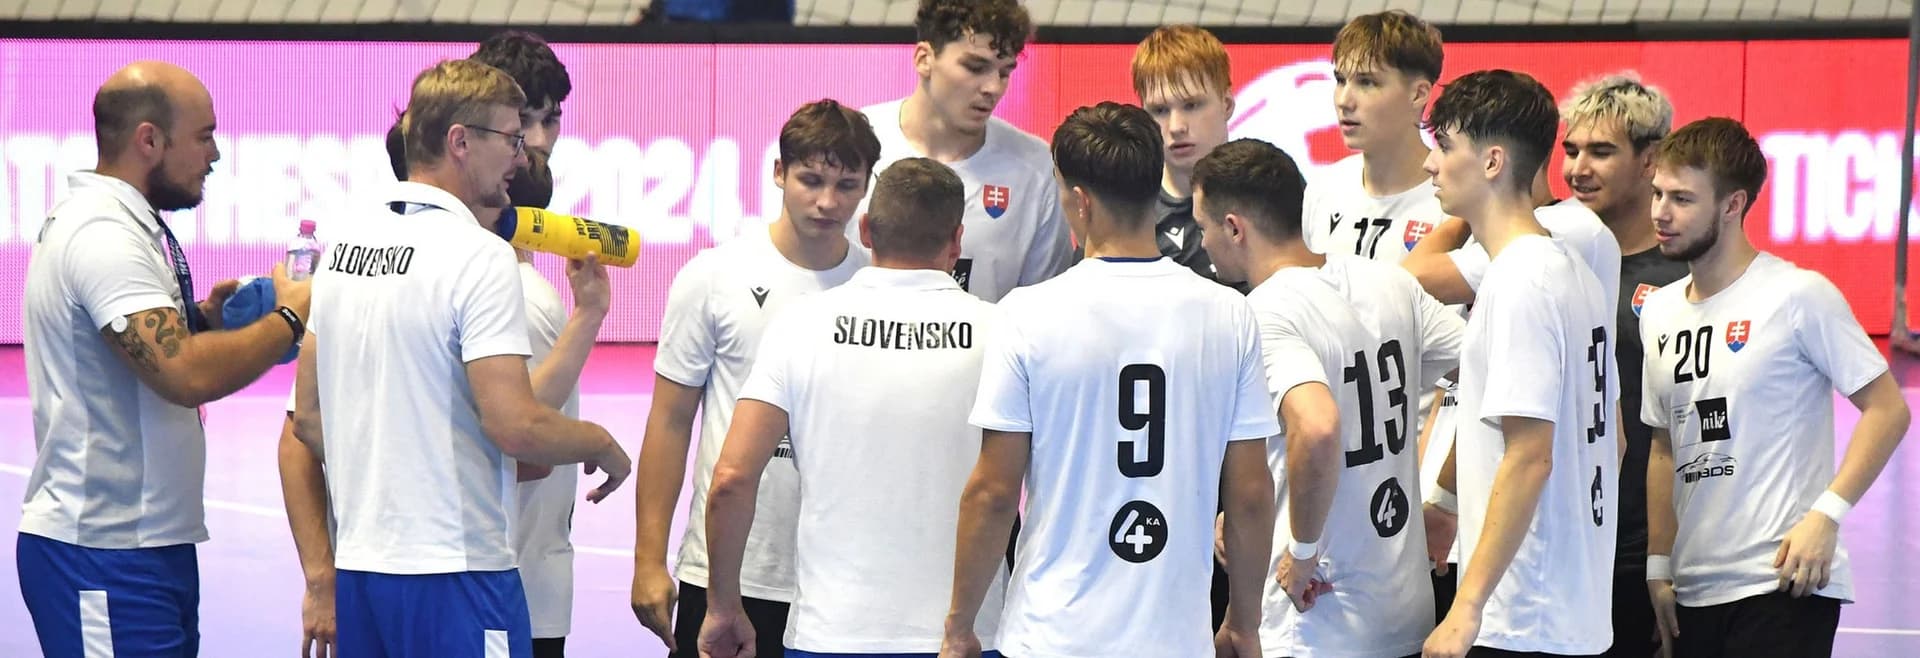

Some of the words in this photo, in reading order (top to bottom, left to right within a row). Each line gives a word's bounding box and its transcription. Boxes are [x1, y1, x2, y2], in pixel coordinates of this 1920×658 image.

[328, 242, 415, 277] SLOVENSKO
[1353, 217, 1393, 260] 17
[833, 314, 973, 350] SLOVENSKO
[1674, 325, 1713, 384] 20
[1117, 363, 1166, 478] 9
[1343, 339, 1408, 469] 13
